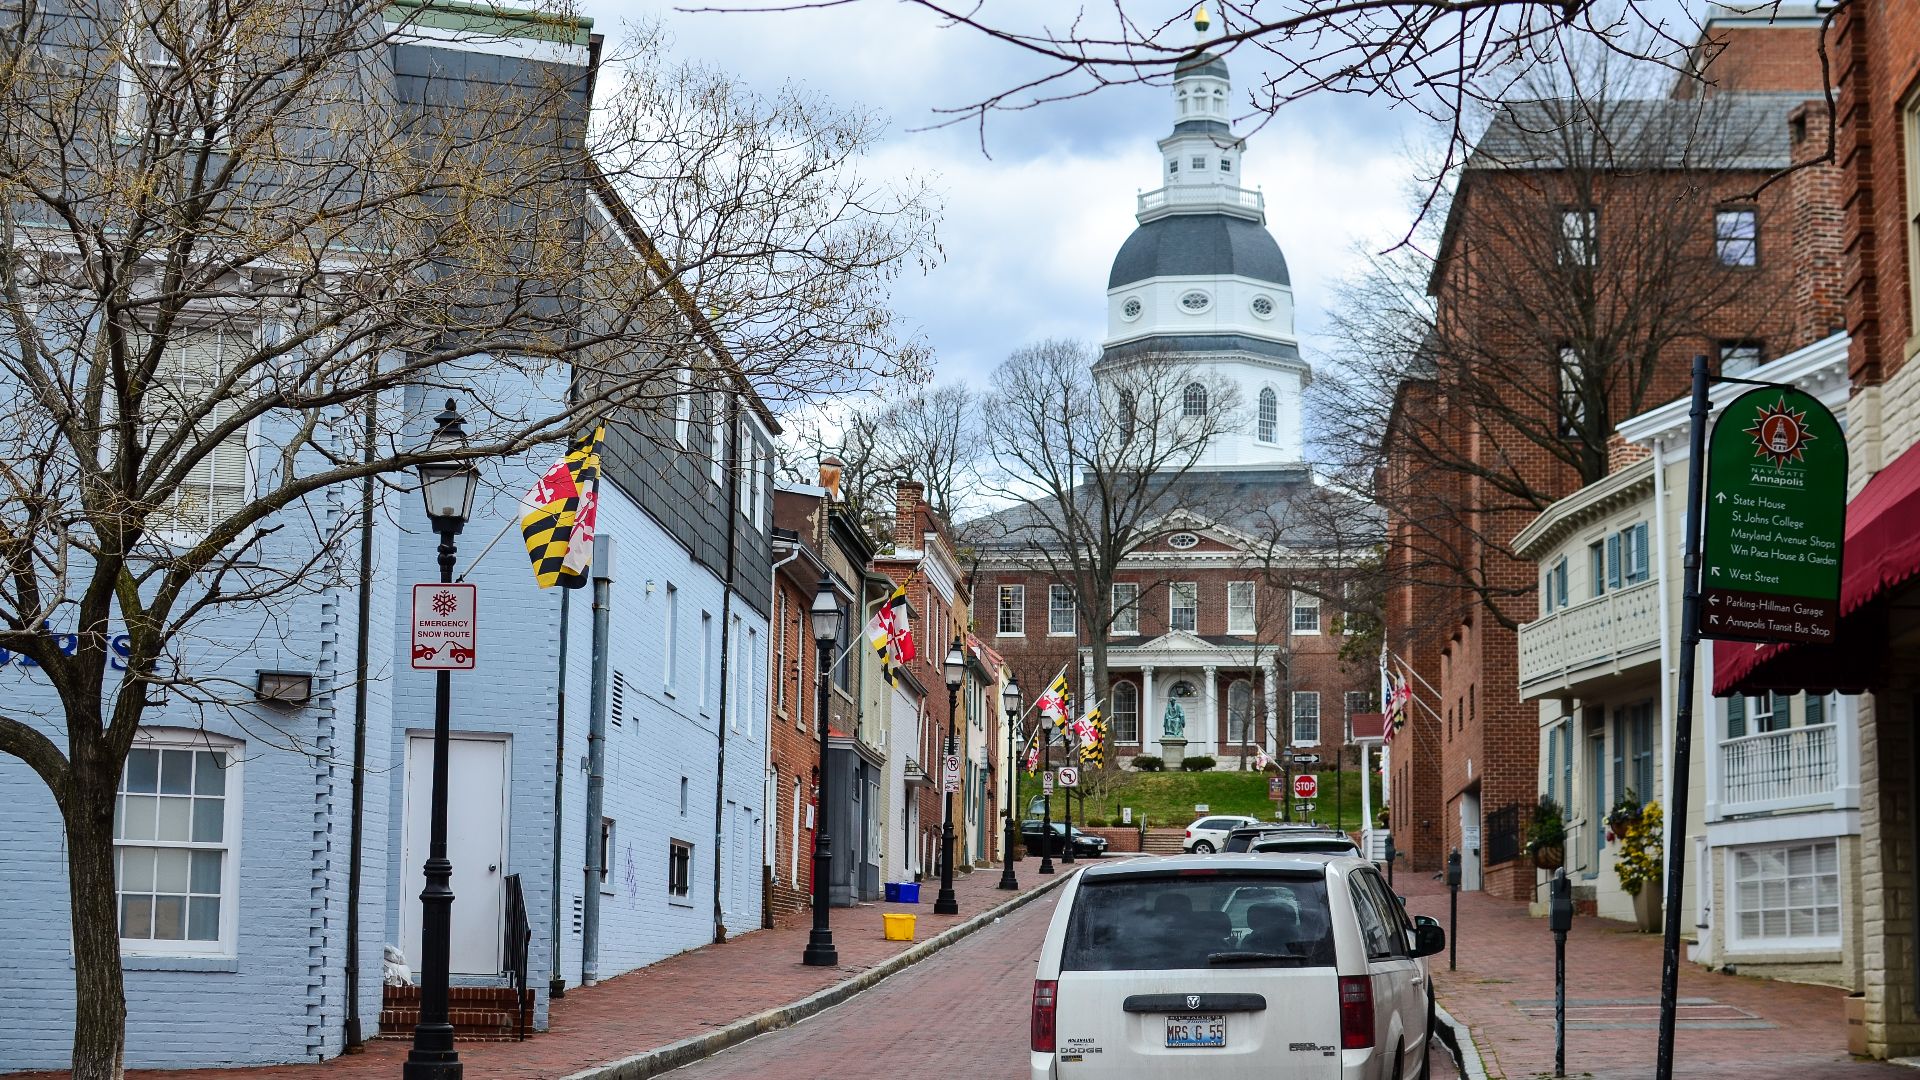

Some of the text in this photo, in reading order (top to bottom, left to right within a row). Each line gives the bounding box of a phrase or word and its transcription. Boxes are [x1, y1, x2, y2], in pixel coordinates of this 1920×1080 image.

[1751, 473, 1804, 487] Annapolis
[1733, 493, 1786, 510] State House
[1732, 510, 1804, 530] St Johns College
[1730, 527, 1836, 549] Maryland Avenue Shops
[1730, 543, 1837, 566] Wm Paca House & Garden
[1729, 567, 1780, 584] West Street
[1726, 595, 1825, 617] Parking-Hillman Garage
[1725, 615, 1831, 637] Annapolis Transit Bus Stop
[1295, 781, 1316, 791] STOP
[1167, 1024, 1223, 1041] MRS G 55
